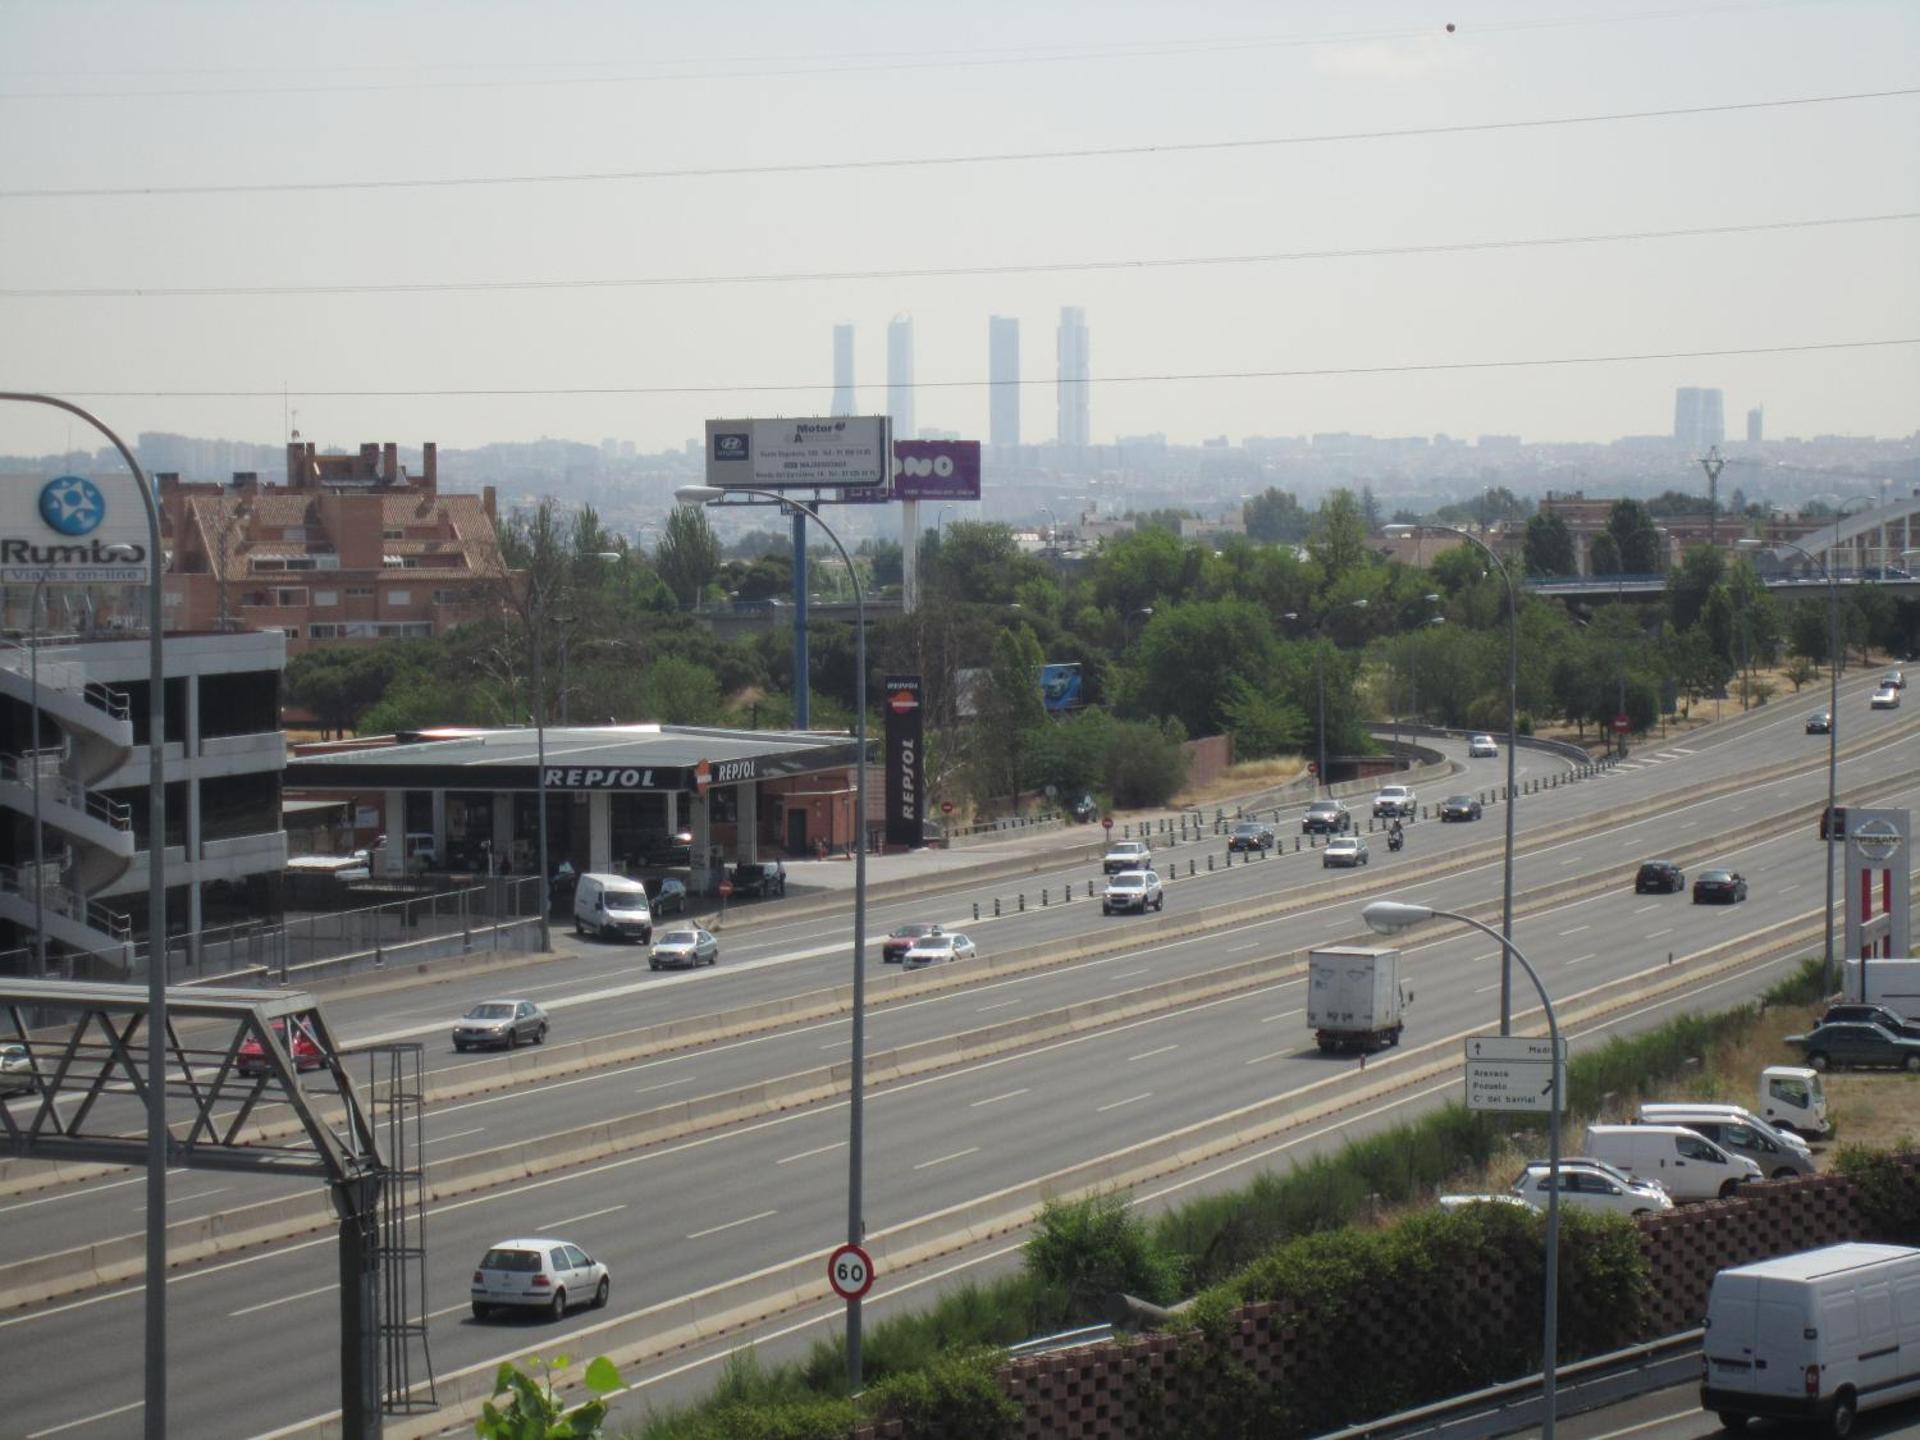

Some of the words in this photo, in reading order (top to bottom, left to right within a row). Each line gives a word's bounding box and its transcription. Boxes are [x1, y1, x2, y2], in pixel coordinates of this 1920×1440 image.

[796, 424, 832, 433] Motor
[1, 538, 146, 564] Rumbo
[76, 569, 138, 580] on-line
[544, 768, 655, 787] REPSOL
[719, 760, 757, 782] REPSOL
[902, 738, 915, 820] REPSOL
[1529, 1046, 1552, 1054] Madr
[838, 1263, 863, 1282] 60
